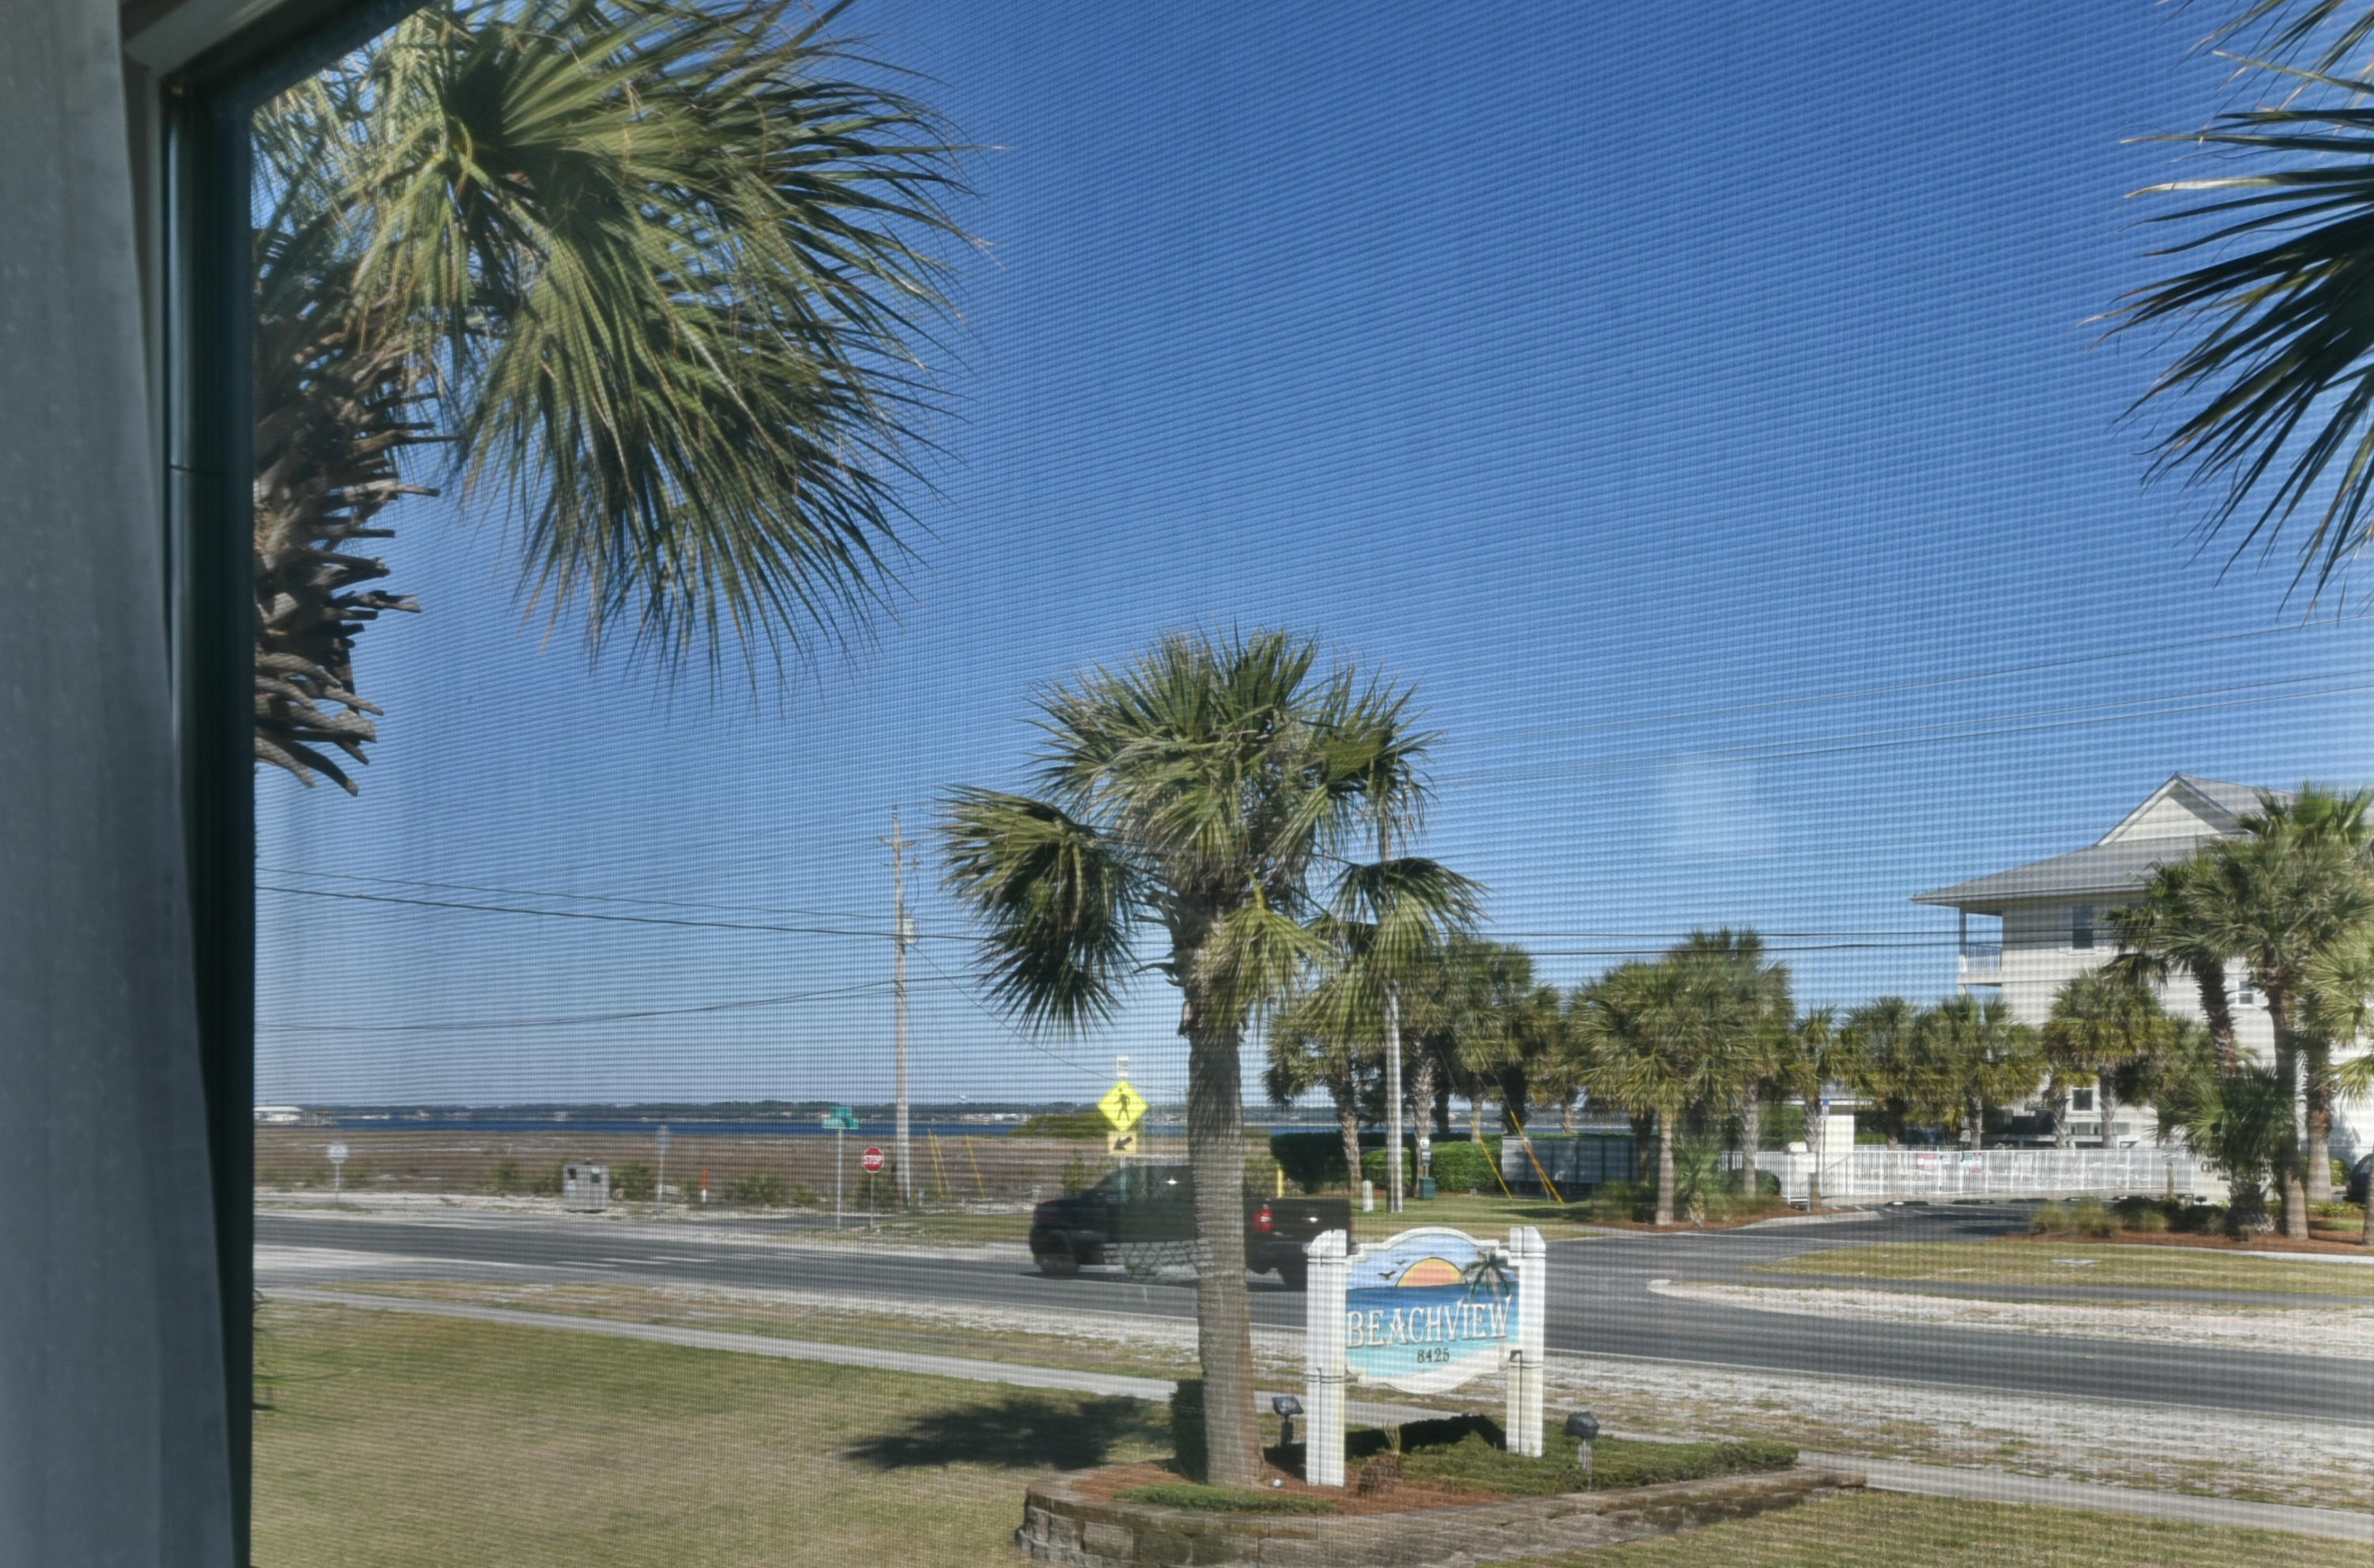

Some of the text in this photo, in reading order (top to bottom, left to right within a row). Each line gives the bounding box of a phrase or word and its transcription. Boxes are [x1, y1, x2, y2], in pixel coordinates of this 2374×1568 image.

[863, 1154, 883, 1165] STOP
[1346, 1294, 1512, 1349] BEACHVIEW
[1416, 1347, 1451, 1363] 8425
